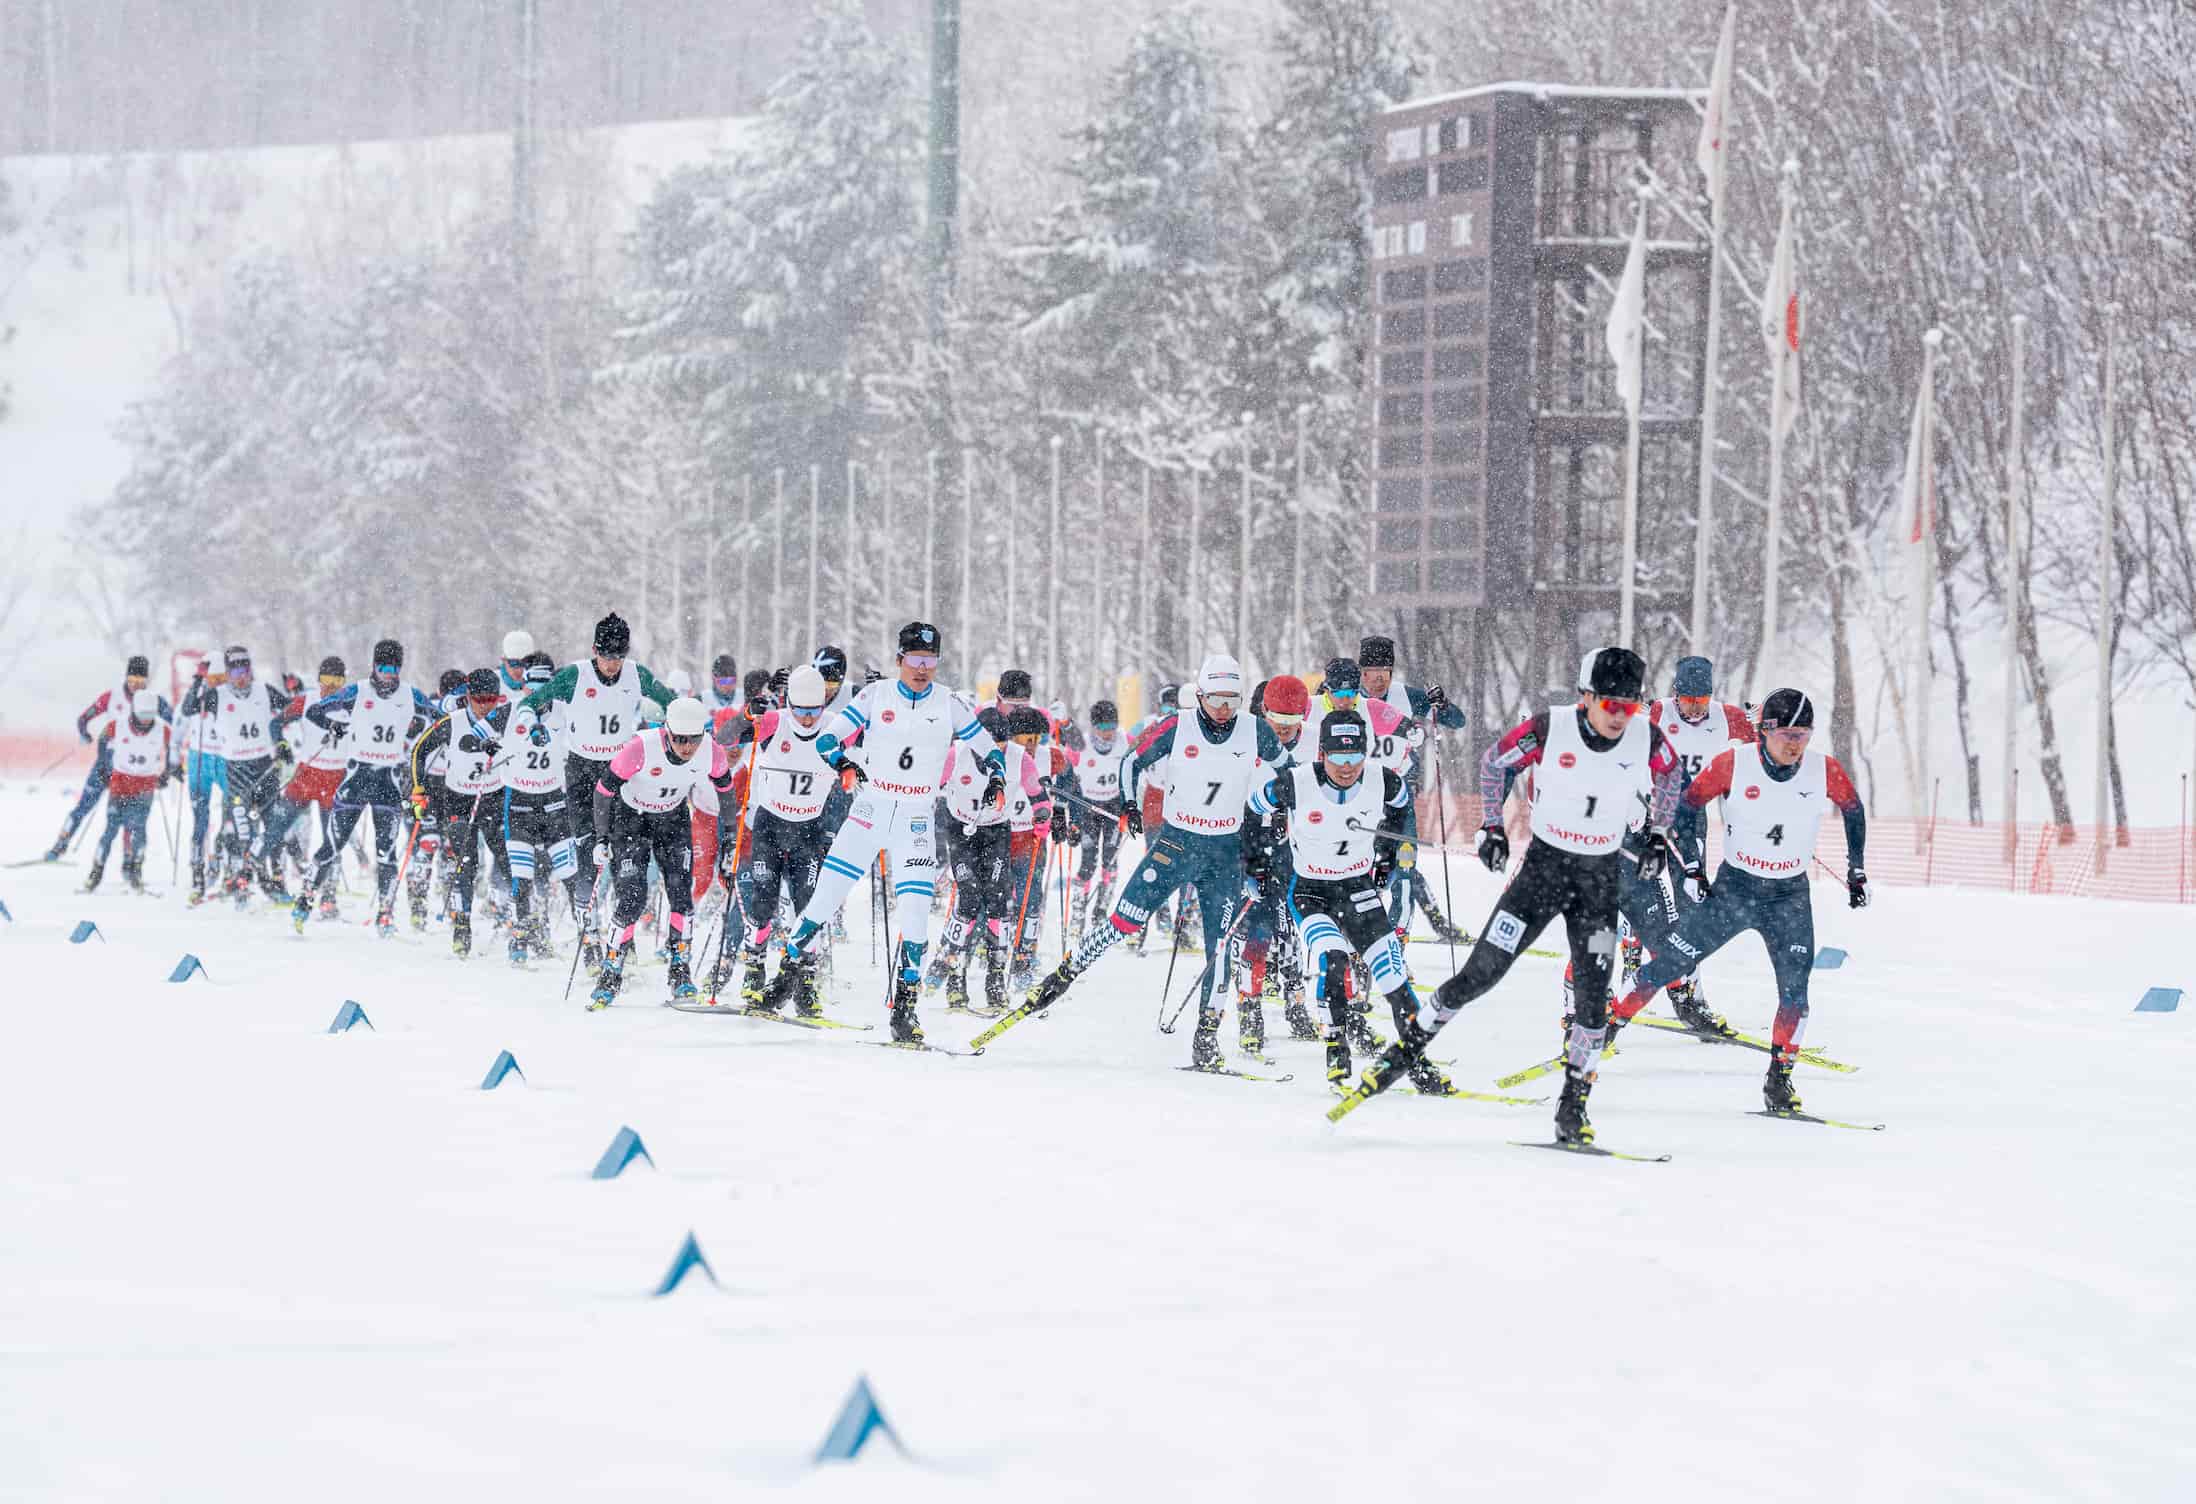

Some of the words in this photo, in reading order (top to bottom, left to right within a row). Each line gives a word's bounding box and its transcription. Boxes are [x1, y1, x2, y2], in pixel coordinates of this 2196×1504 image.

[240, 723, 259, 739] 46
[372, 725, 395, 743] 36
[599, 714, 620, 735] 16
[582, 743, 624, 753] SAPPOR
[898, 747, 914, 770] 6
[527, 751, 550, 770] 26
[1680, 755, 1704, 775] 15
[790, 774, 813, 796] 12
[873, 778, 932, 796] SAPPORO
[1203, 782, 1223, 806] 7
[1584, 795, 1598, 818] 1
[1175, 811, 1236, 828] SAPPORO
[1765, 824, 1784, 846] 4
[1736, 850, 1801, 872] SAPPORO
[1118, 898, 1151, 922] SHIGA
